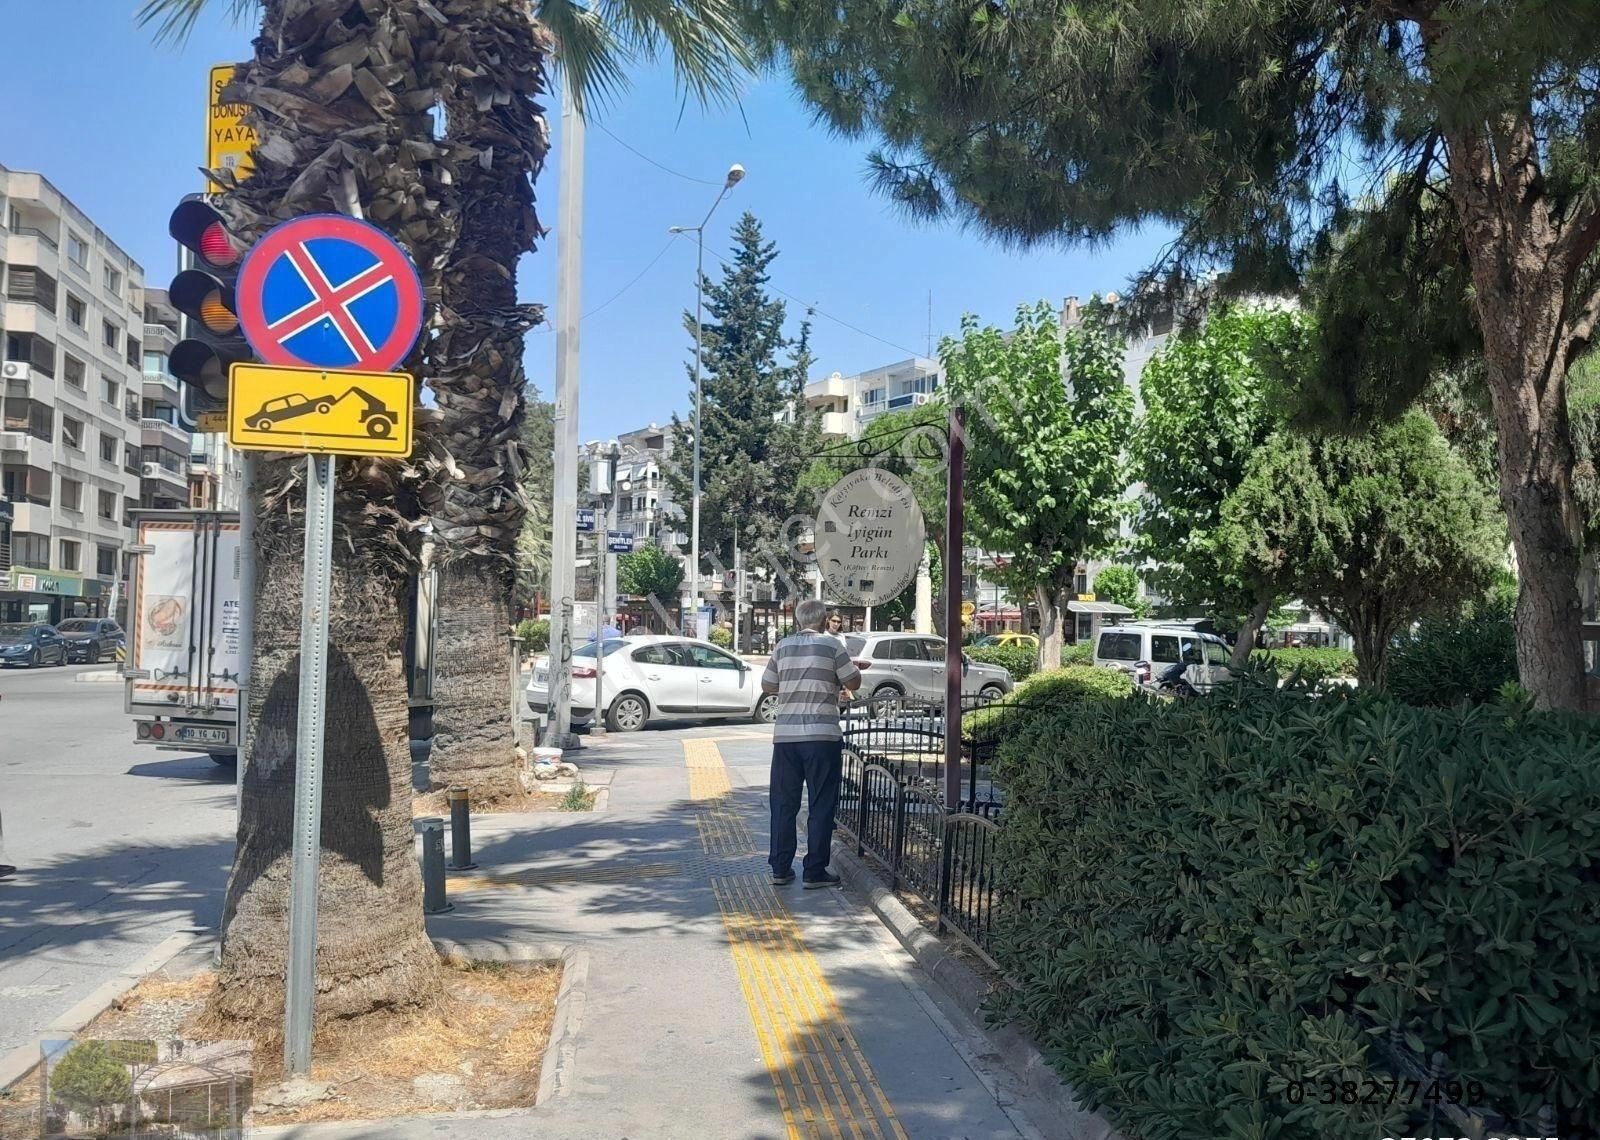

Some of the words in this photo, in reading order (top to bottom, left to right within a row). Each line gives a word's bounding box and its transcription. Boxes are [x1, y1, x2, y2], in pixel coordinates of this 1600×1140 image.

[215, 127, 255, 143] YAYA
[874, 473, 911, 509] Belediesi
[848, 504, 893, 518] Remzi
[847, 522, 892, 542] İyigün
[851, 545, 888, 559] Parkı
[843, 564, 869, 573] (Köftec
